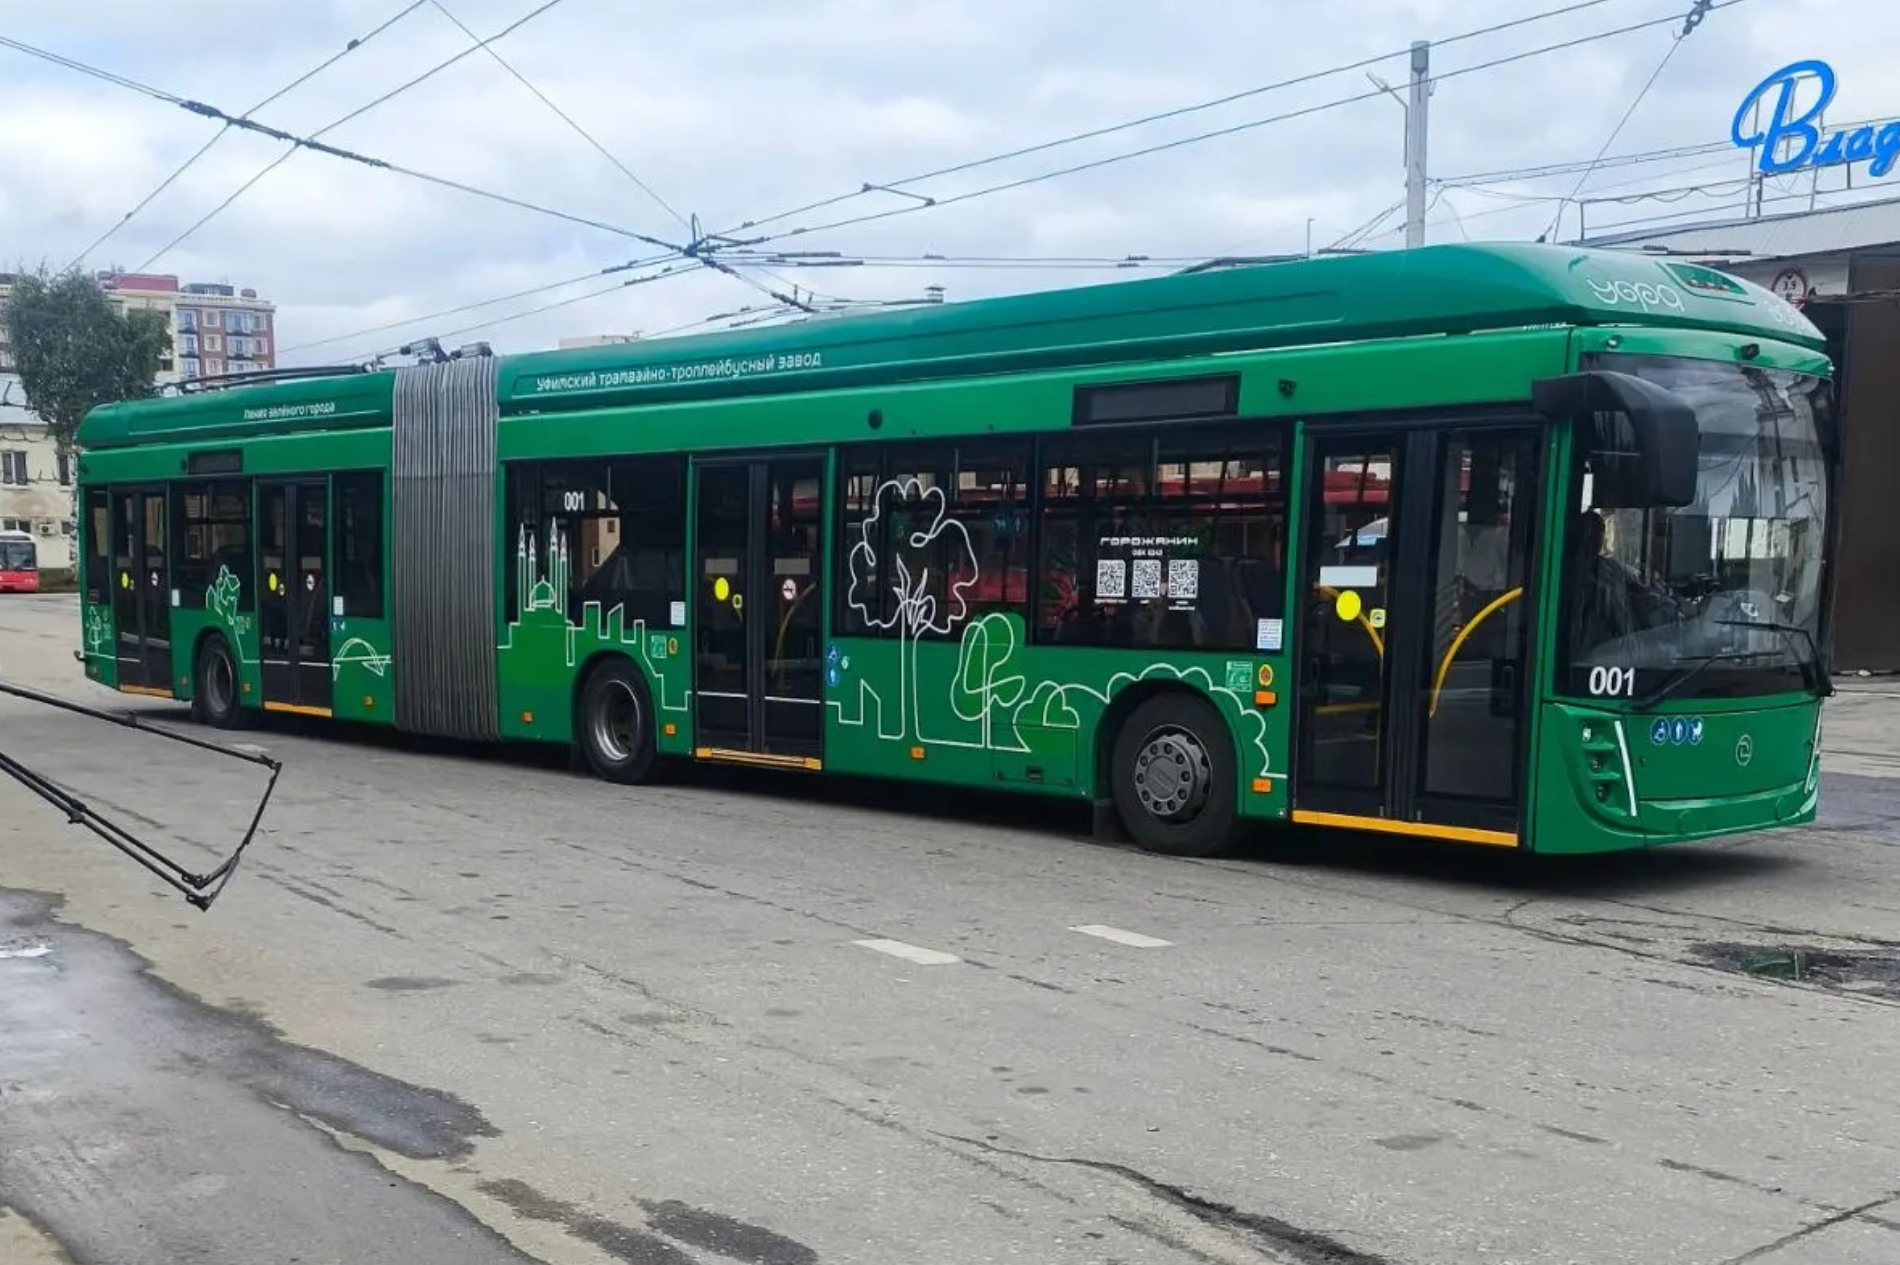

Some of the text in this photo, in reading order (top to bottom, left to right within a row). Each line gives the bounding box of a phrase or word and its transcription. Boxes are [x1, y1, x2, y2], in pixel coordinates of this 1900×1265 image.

[537, 352, 821, 391] Уфимский трамвайно-троллейбусный завод
[305, 402, 335, 417] города
[564, 491, 584, 511] 001
[1100, 537, 1198, 546] ГОРОЖАНИН
[1589, 666, 1635, 696] 001
